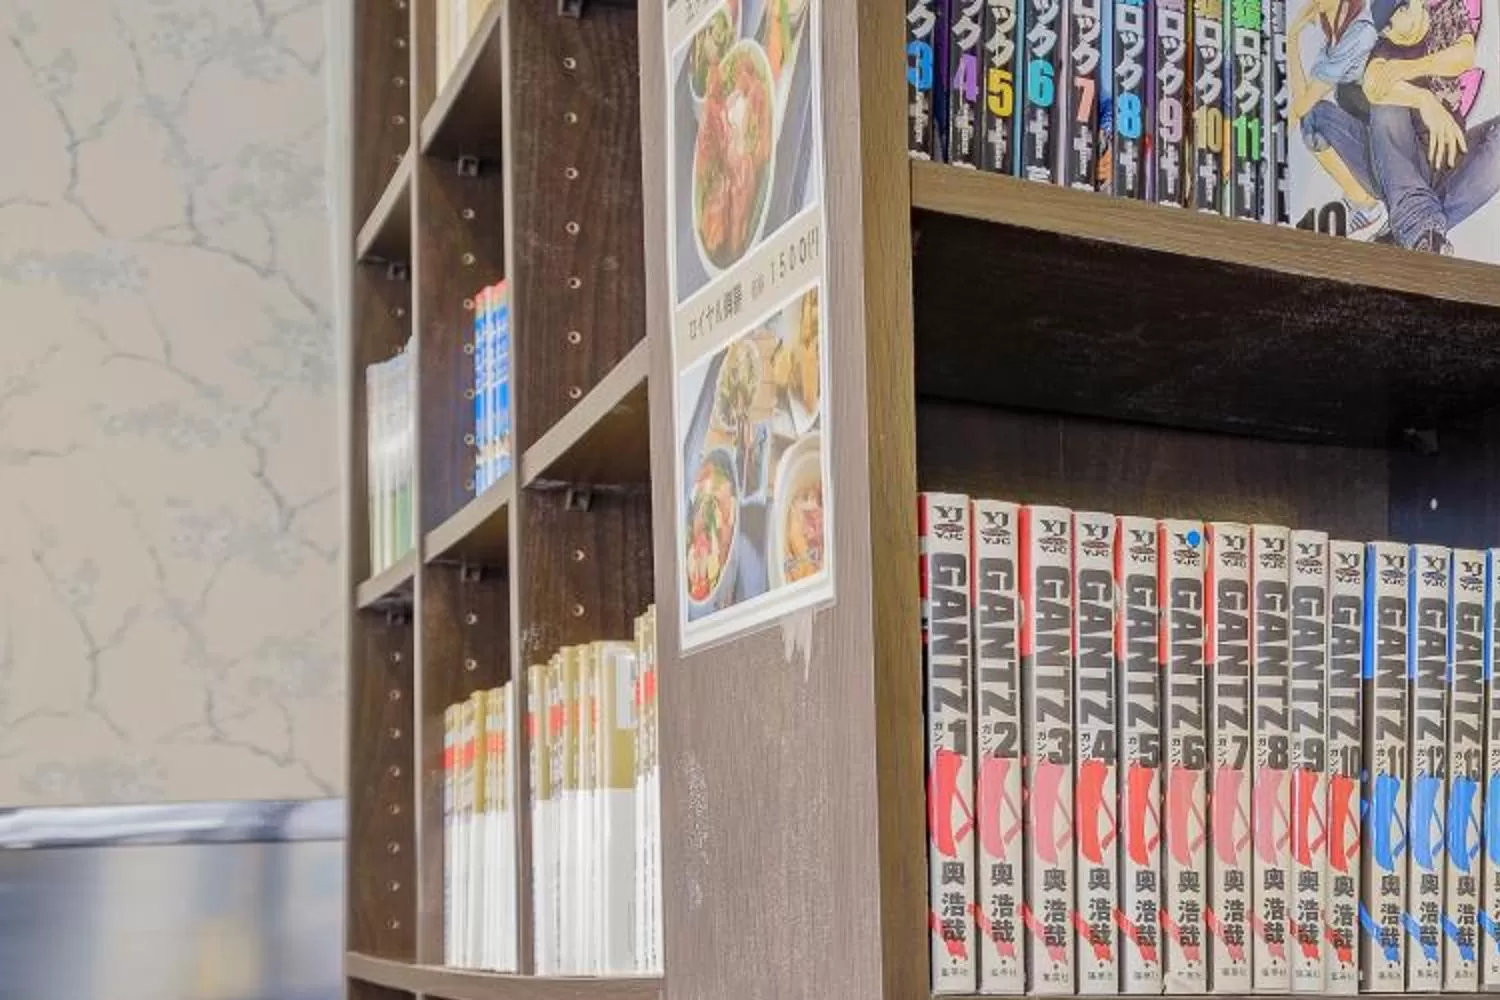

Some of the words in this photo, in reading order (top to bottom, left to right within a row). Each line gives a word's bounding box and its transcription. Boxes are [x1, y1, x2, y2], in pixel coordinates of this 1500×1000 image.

[906, 40, 933, 91] 3
[1115, 0, 1144, 91] ロック
[953, 53, 978, 103] 4
[987, 69, 1013, 118] 5
[1028, 60, 1055, 107] 6
[1073, 77, 1095, 123] 7
[1118, 93, 1142, 139] 8
[1159, 98, 1184, 143] 9
[1194, 106, 1223, 153] 10
[1233, 116, 1261, 161] 11
[932, 553, 968, 714] GANTZ
[980, 557, 1016, 718] GANTZ
[1036, 566, 1071, 726] GANTZ
[1079, 569, 1113, 726] GANTZ
[1127, 574, 1159, 729] GANTZ
[1170, 578, 1203, 735] GANTZ
[1217, 581, 1248, 735] GANTZ
[1257, 580, 1289, 735] GANTZ
[1292, 586, 1325, 735] GANTZ
[1330, 595, 1361, 741] GANTZ
[1377, 596, 1406, 743] GANTZ
[1417, 598, 1446, 743] GANTZ
[1454, 601, 1484, 745] GANTZ
[948, 719, 968, 756] 1
[993, 721, 1018, 759] 2
[1047, 727, 1071, 765] 3
[1092, 730, 1115, 767] 4
[1136, 732, 1159, 769] 5
[1182, 735, 1205, 770] 6
[1231, 736, 1249, 770] 7
[1268, 735, 1289, 770] 8
[1303, 738, 1325, 773] 9
[1340, 745, 1361, 780] 10
